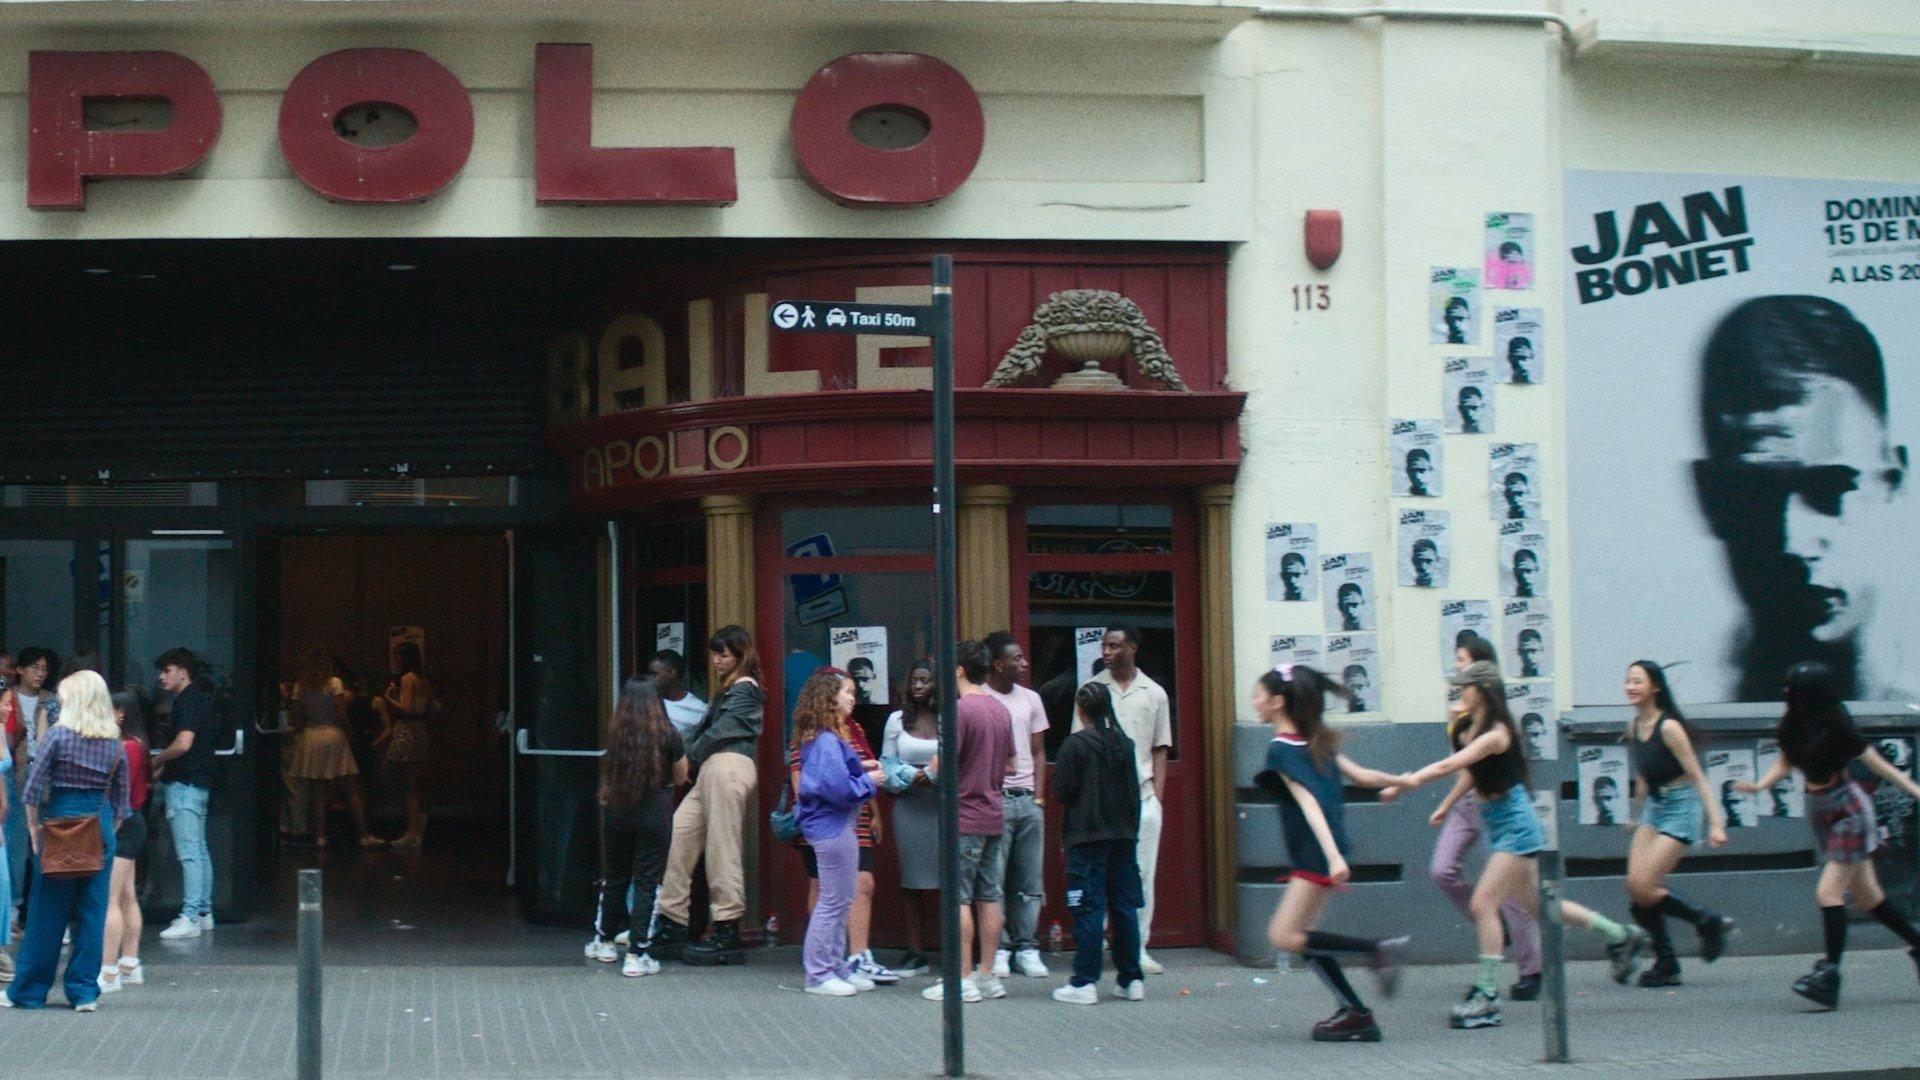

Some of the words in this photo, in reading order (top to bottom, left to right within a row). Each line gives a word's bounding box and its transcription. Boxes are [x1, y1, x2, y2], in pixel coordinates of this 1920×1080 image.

[1571, 185, 1750, 265] JAN
[1825, 224, 1856, 245] 15
[1864, 221, 1899, 242] DE
[1576, 238, 1754, 305] BONET
[1828, 267, 1846, 283] A
[1852, 265, 1894, 282] LAS
[1292, 285, 1331, 310] 113
[850, 312, 881, 326] Taxi
[884, 313, 916, 327] 50m
[549, 285, 936, 421] BAILE
[583, 425, 749, 489] APOLO
[833, 629, 858, 641] JAN
[1078, 629, 1102, 641] JAN
